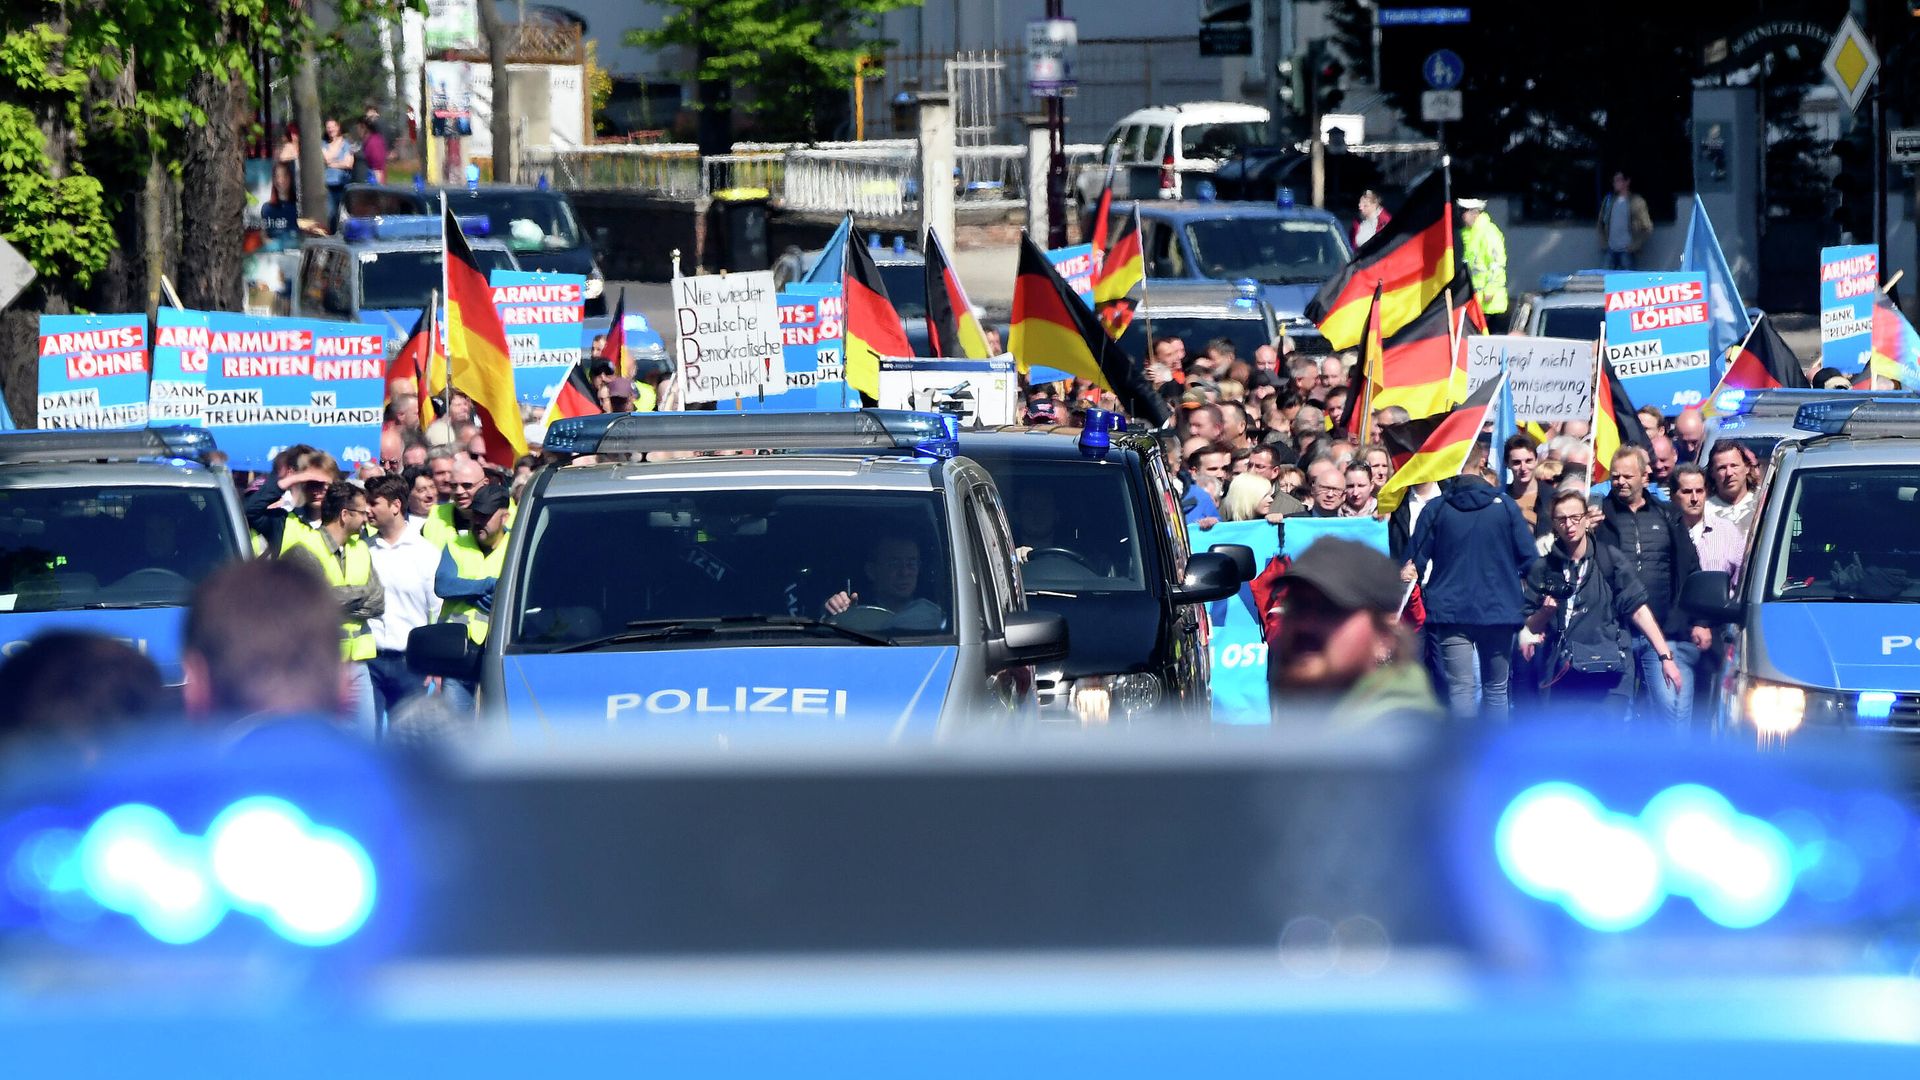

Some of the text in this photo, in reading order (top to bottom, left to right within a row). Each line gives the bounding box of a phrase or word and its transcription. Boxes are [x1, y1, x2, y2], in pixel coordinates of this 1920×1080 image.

[1822, 254, 1875, 280] ARMUTS-
[492, 285, 580, 303] ARMUTS-
[683, 278, 765, 306] Nie wieder
[1608, 282, 1702, 312] ARMUTS-
[503, 306, 579, 324] RENTEN
[678, 306, 758, 337] Deutsche
[1631, 304, 1704, 331] LÖHNE
[1825, 309, 1853, 324] DANK
[42, 327, 142, 356] ARMUTS-
[211, 331, 312, 353] ARMUTS-
[315, 336, 382, 356] MUTS-
[682, 332, 781, 365] Demokratische
[1610, 342, 1659, 360] DANK
[66, 350, 144, 380] LÖHNE
[224, 356, 310, 377] RENTEN
[1541, 348, 1576, 368] nicht
[43, 391, 95, 410] DANK
[207, 391, 258, 405] DANK
[1672, 389, 1702, 406] AfD
[43, 404, 147, 429] TREUHAND!
[205, 409, 308, 424] TREUHAND!
[312, 409, 381, 424] UHAND!
[606, 686, 847, 720] POLIZEI
